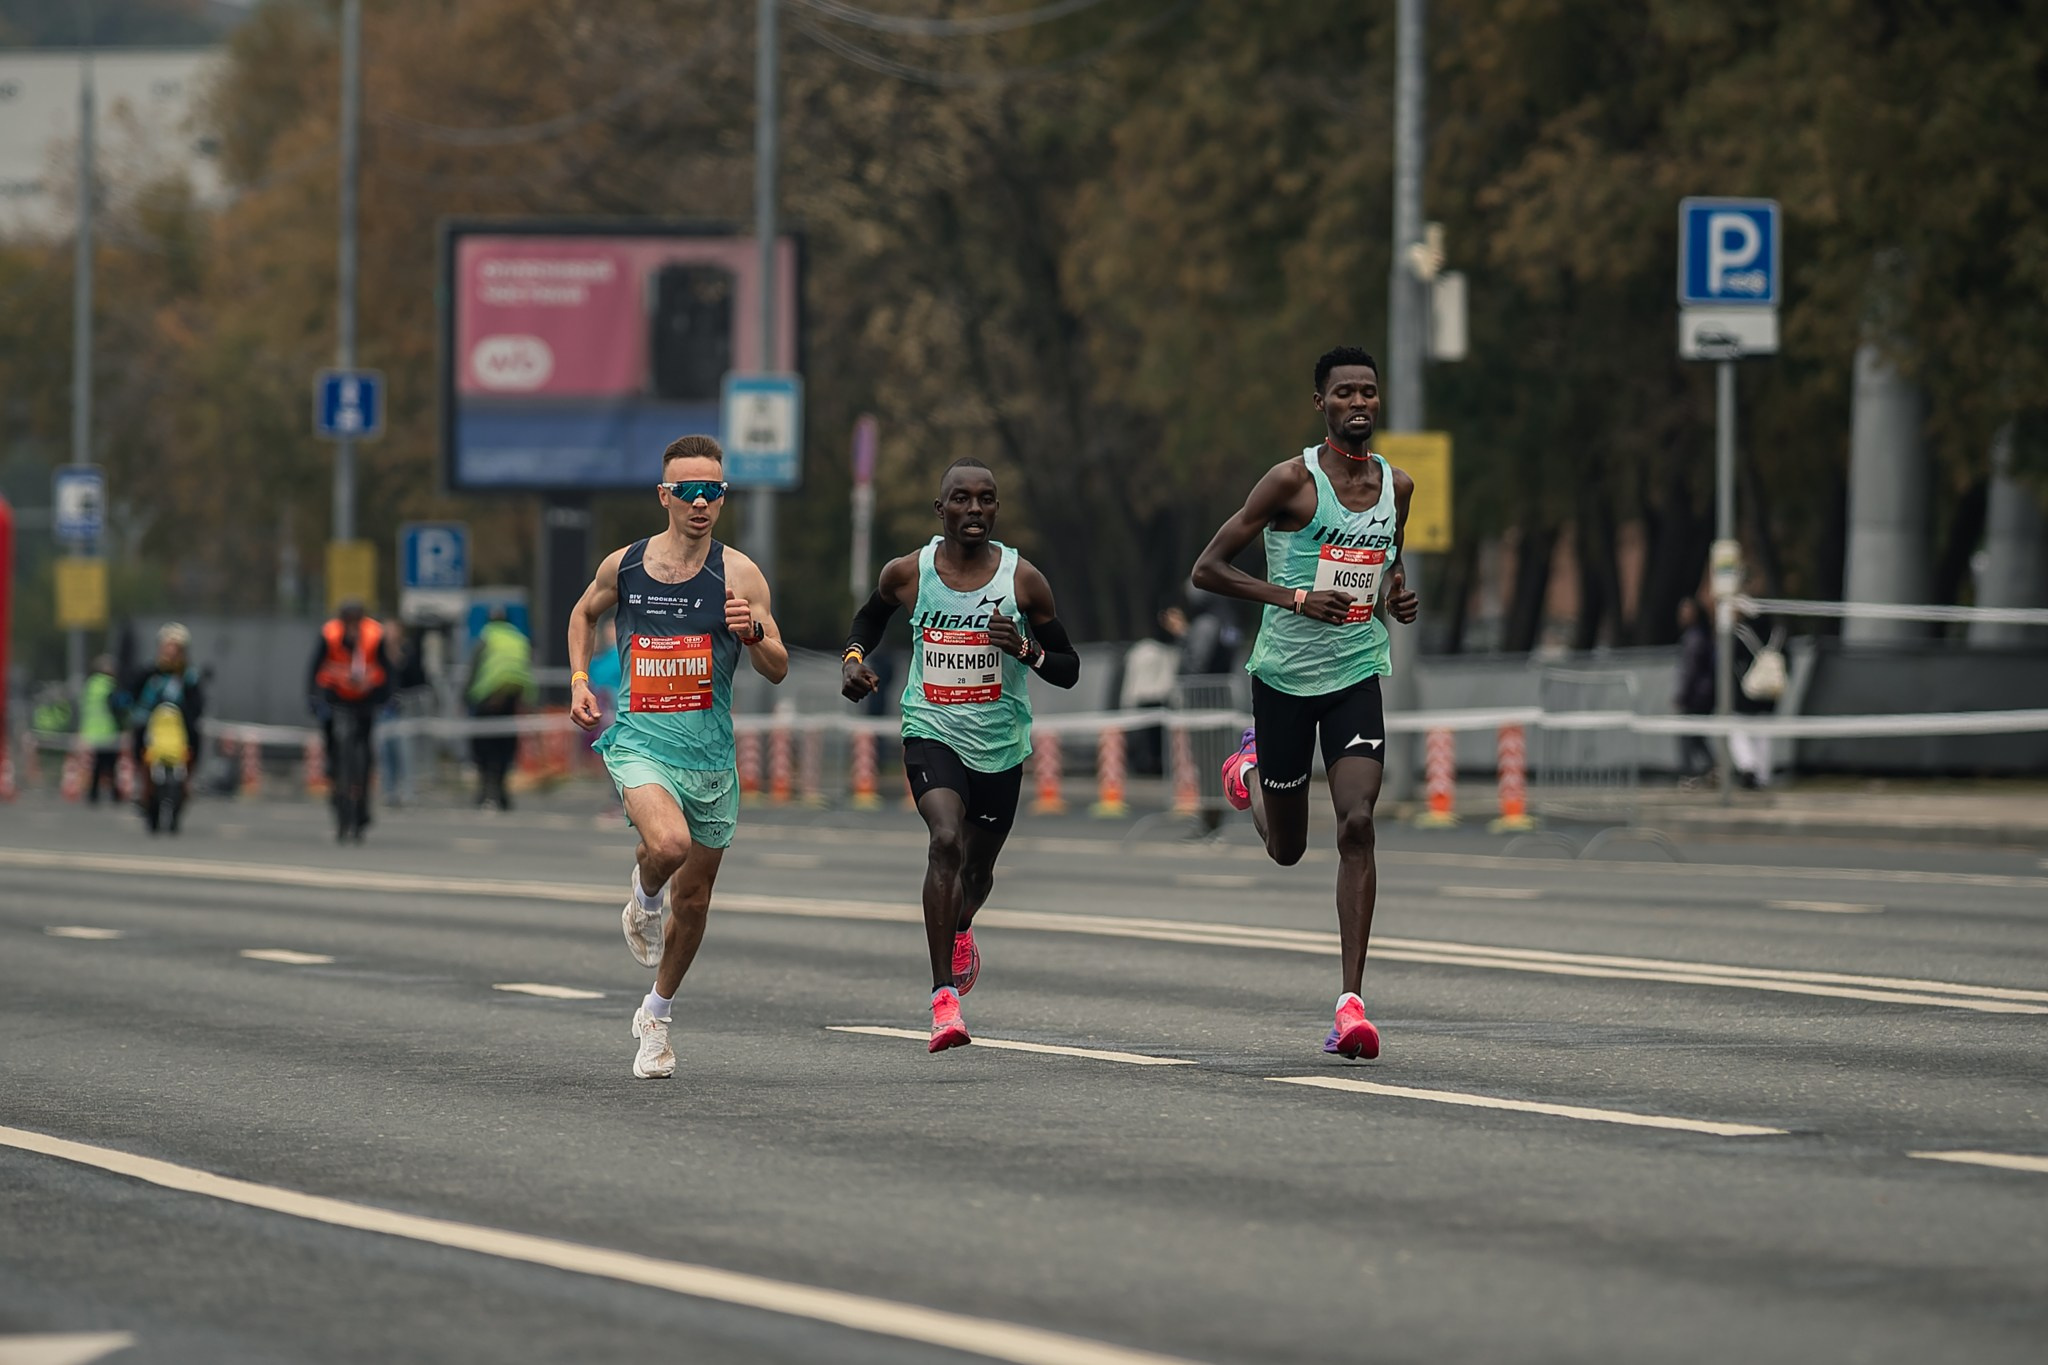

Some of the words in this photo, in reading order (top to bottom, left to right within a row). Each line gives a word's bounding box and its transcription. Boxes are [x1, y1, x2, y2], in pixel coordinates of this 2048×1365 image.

[1708, 212, 1762, 296] P
[1333, 570, 1375, 588] KOSGEI
[919, 610, 1013, 629] HIRAC
[636, 657, 707, 677] НИКИТИН
[925, 650, 999, 669] KIPKEMBOI
[668, 682, 673, 690] 1
